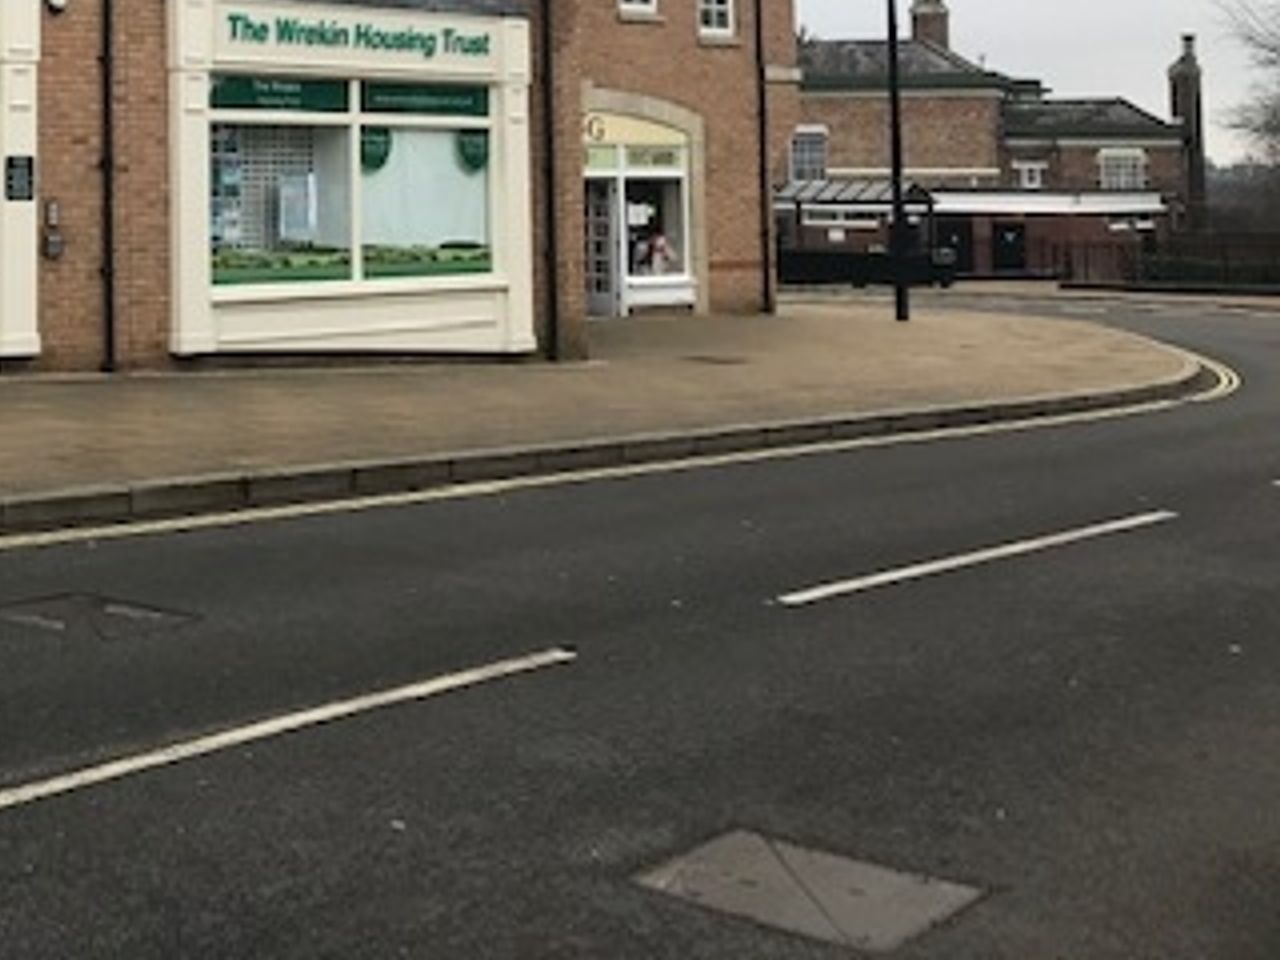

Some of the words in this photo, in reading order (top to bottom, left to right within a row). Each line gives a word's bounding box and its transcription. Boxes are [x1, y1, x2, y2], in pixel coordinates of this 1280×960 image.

[227, 14, 269, 42] The
[275, 17, 349, 47] Wrekin
[352, 22, 436, 59] Housing
[442, 28, 491, 57] Trust
